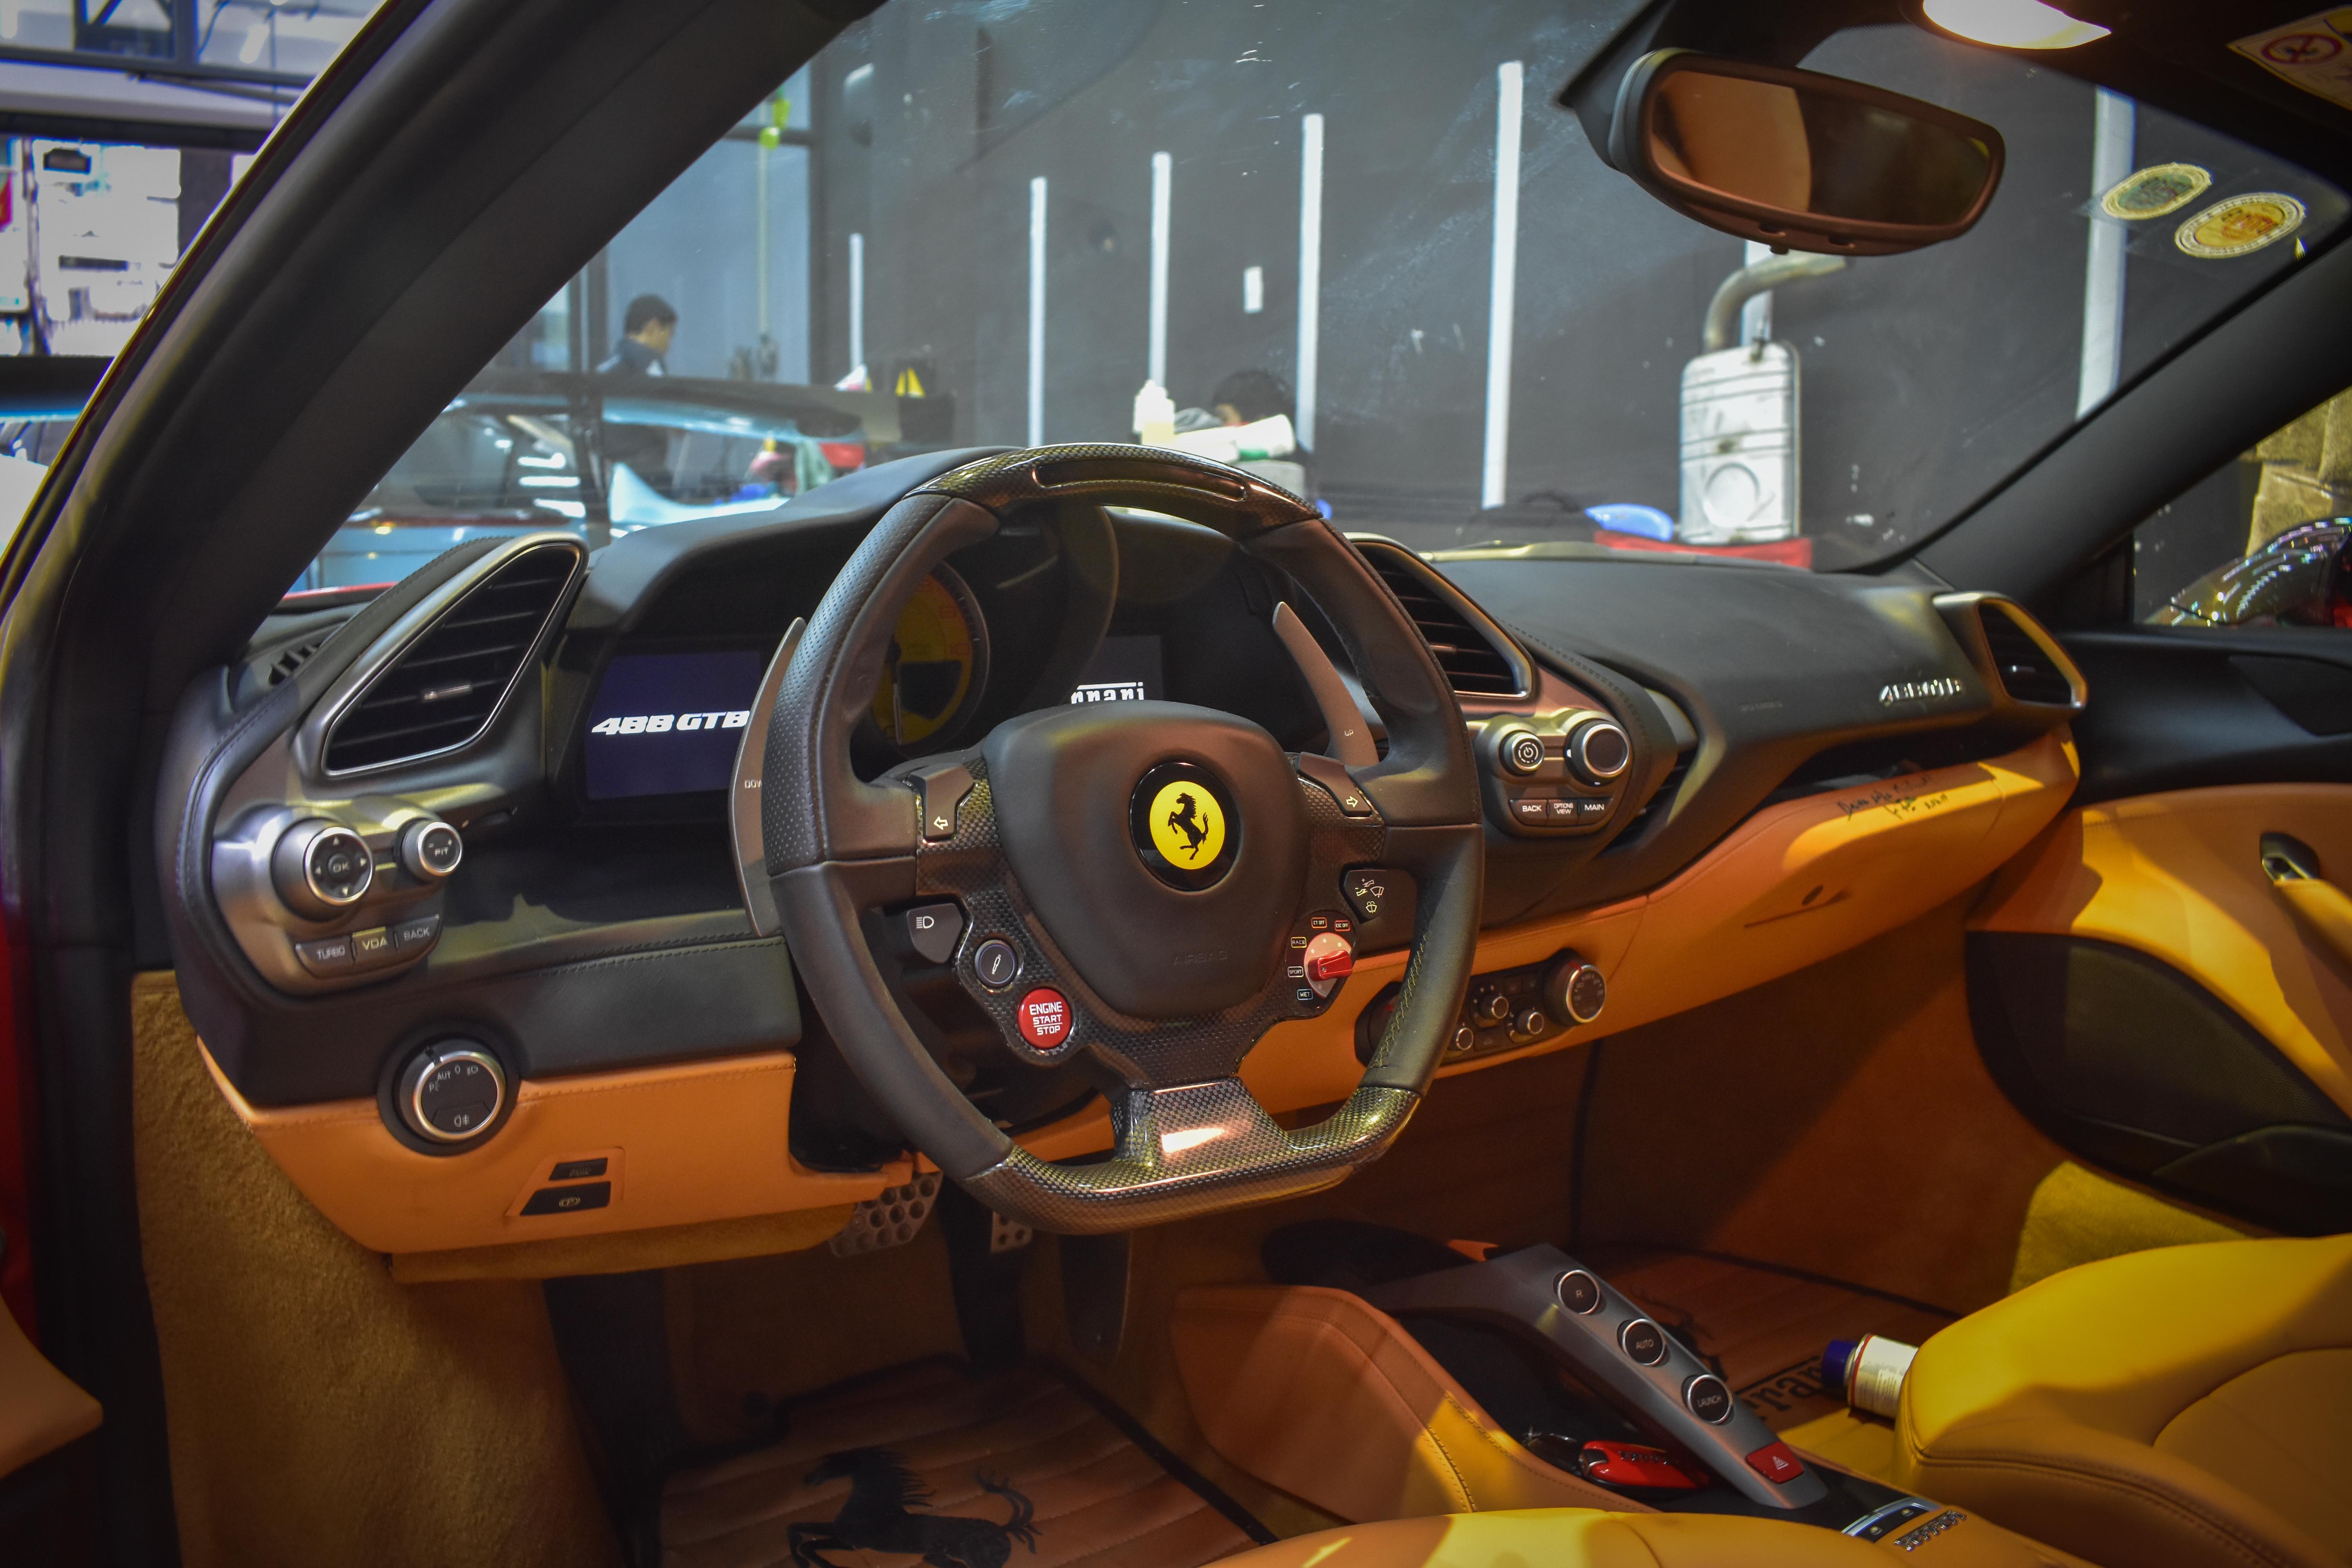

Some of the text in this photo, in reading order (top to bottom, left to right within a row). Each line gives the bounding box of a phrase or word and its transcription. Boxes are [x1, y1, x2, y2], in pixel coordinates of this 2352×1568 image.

[592, 710, 750, 735] 488 GTB
[744, 779, 762, 788] DOW
[434, 847, 449, 857] PIT
[332, 862, 350, 873] OK
[404, 926, 430, 941] BACK
[361, 936, 388, 950] VDA
[316, 945, 345, 960] TURBO
[1029, 1001, 1063, 1015] ENGINE
[1033, 1014, 1062, 1025] START
[1037, 1025, 1060, 1036] STOP
[1576, 1289, 1583, 1299] R
[1635, 1339, 1654, 1350] AUTO
[1696, 1394, 1722, 1407] LAUNCH
